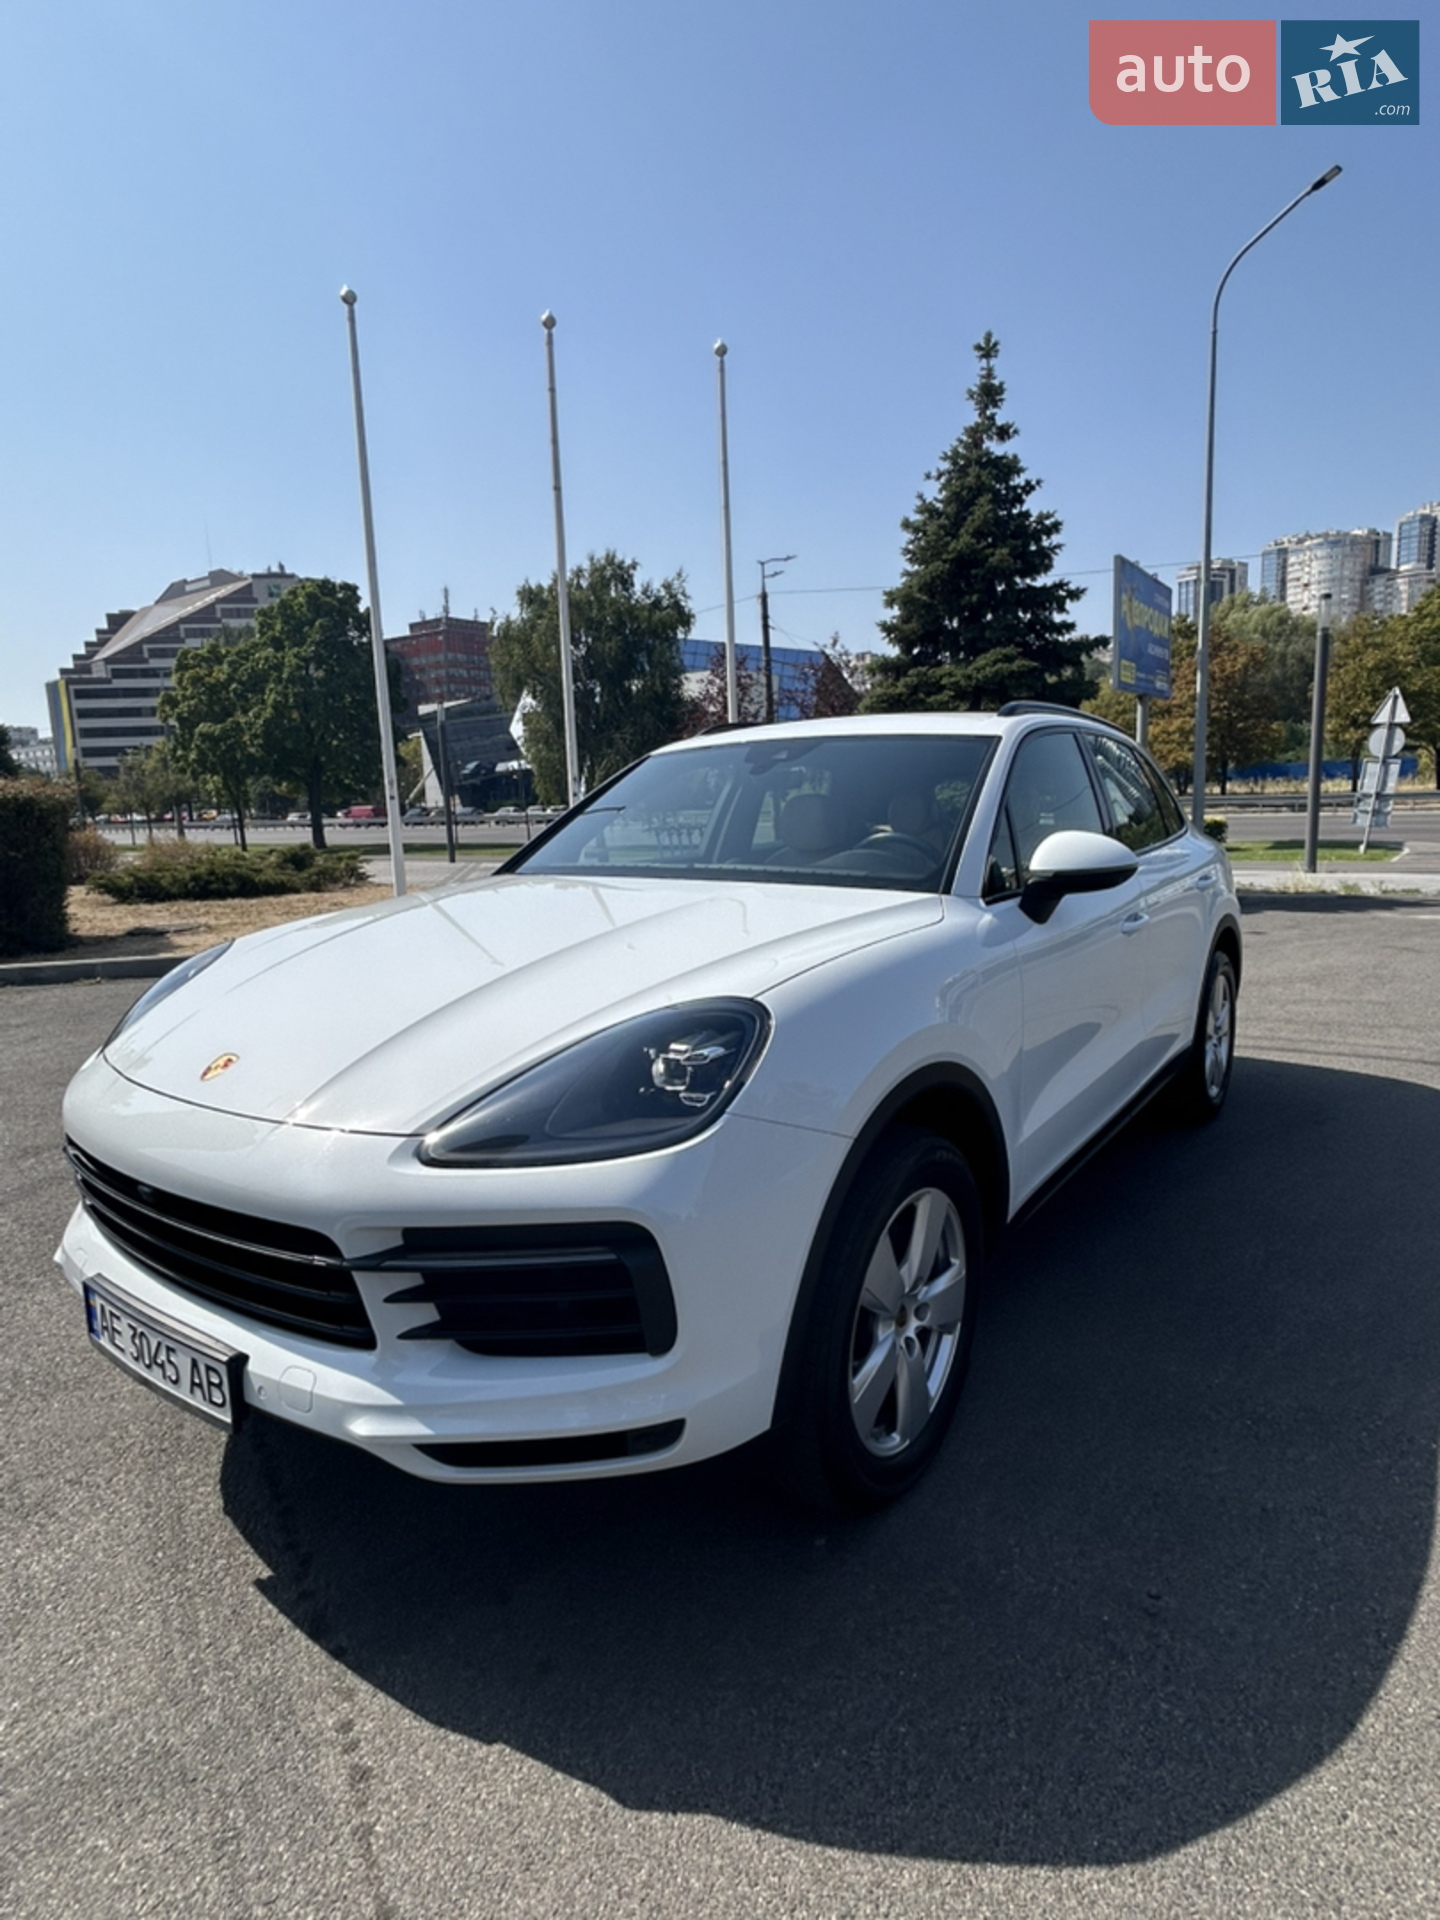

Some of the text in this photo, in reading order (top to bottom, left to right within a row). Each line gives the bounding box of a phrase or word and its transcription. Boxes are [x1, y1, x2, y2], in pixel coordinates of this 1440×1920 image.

[100, 1302, 227, 1408] AE 3045 AB
